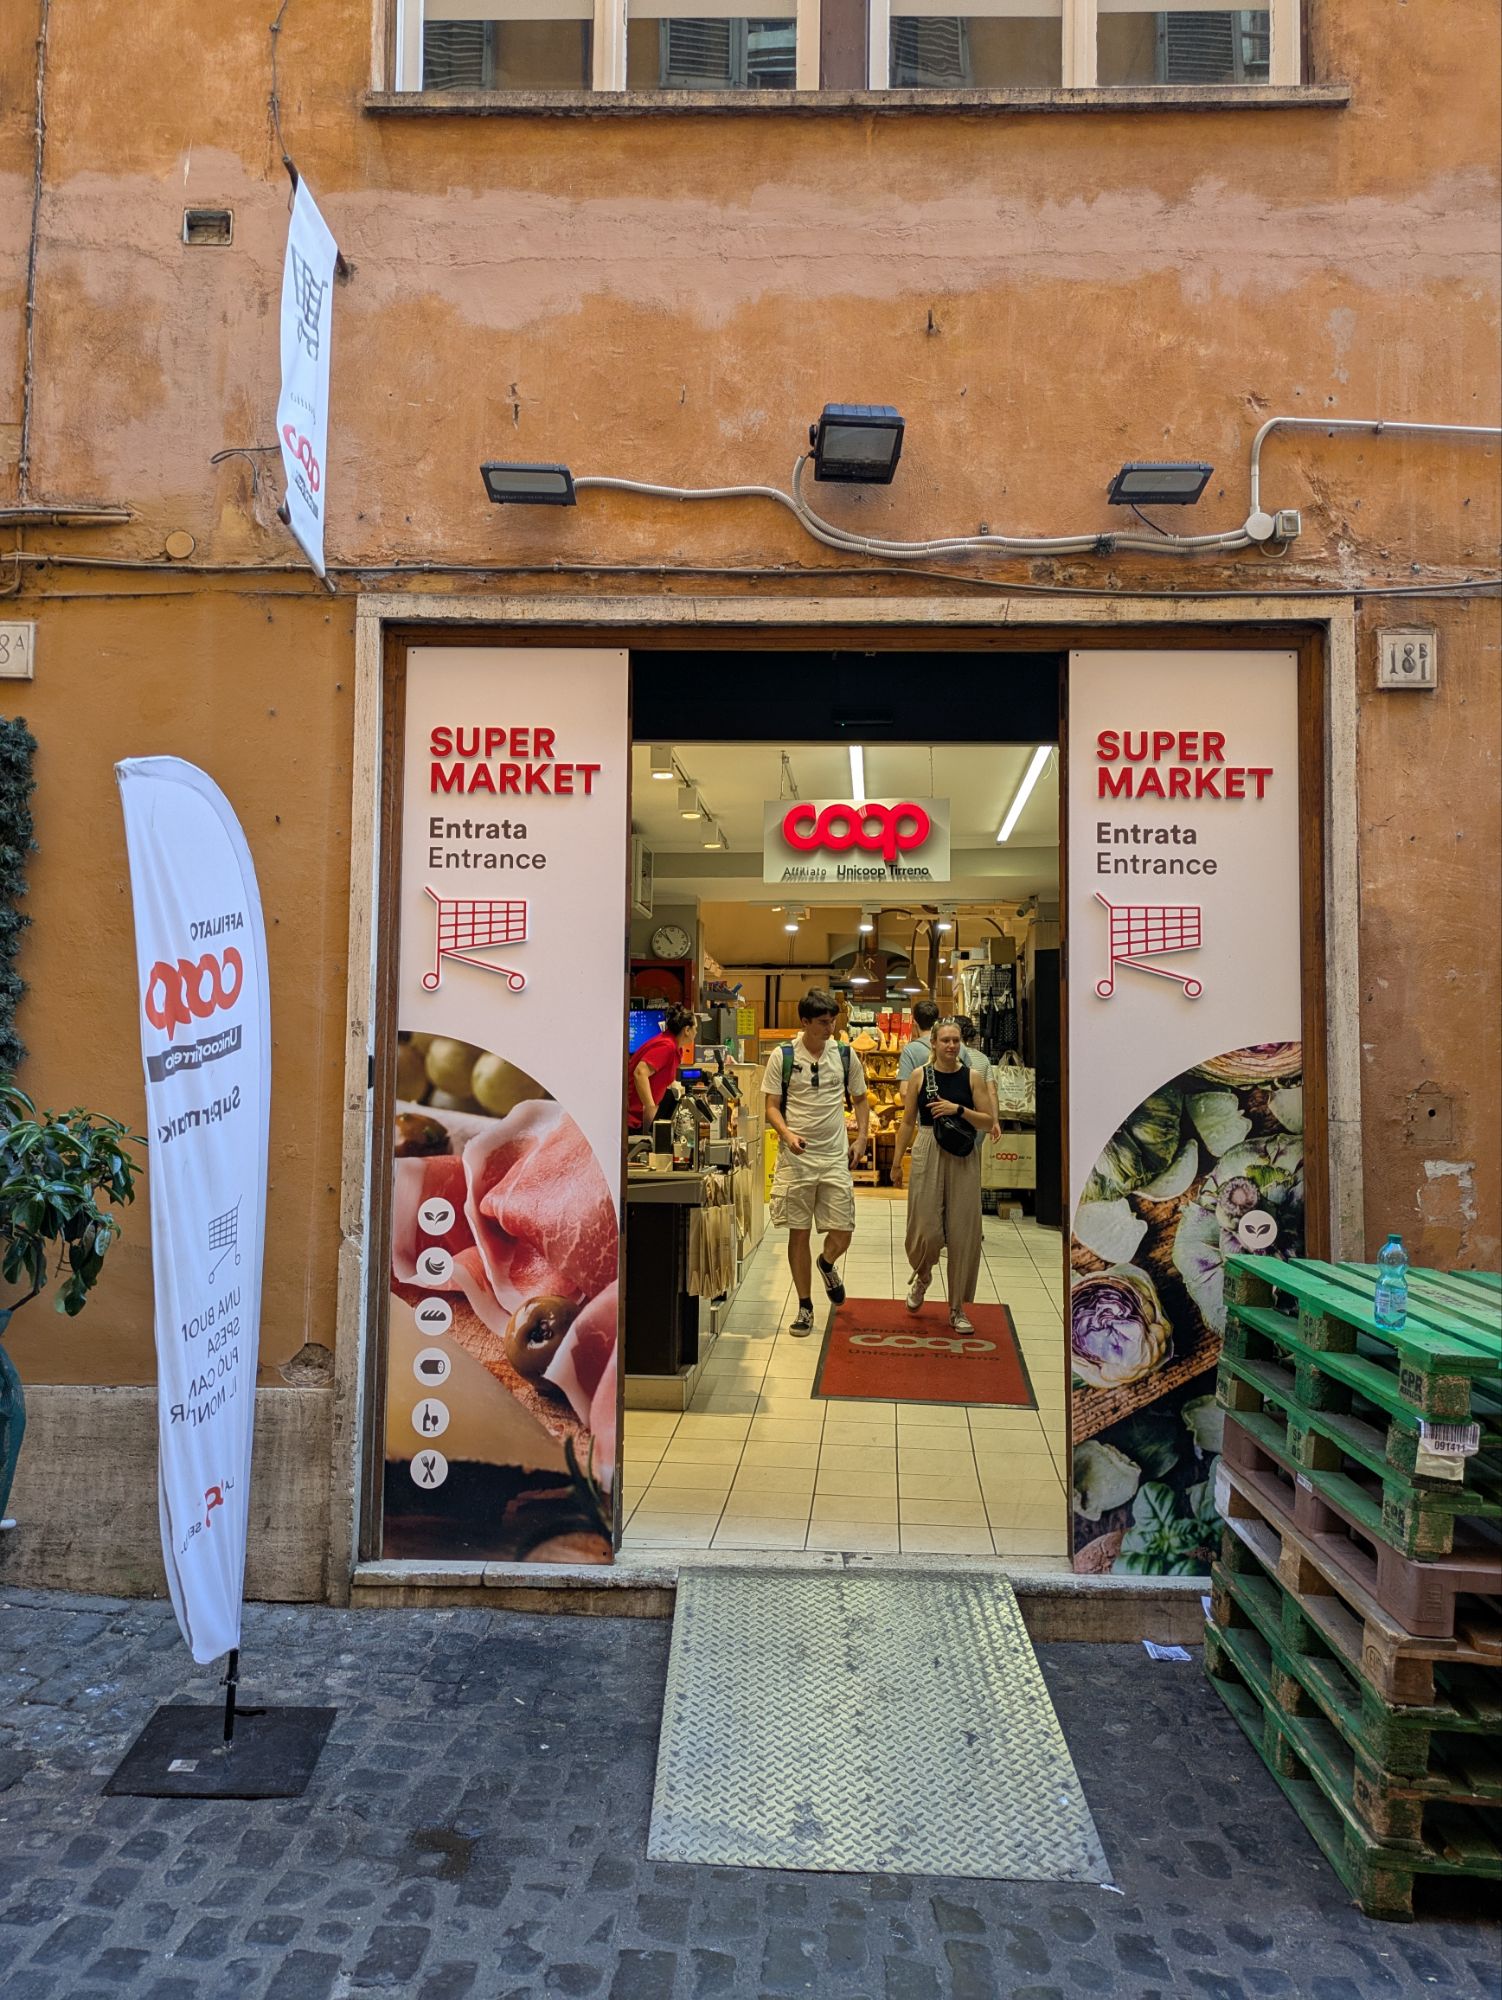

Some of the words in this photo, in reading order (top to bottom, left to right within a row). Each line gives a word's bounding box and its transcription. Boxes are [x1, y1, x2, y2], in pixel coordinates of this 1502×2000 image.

[430, 727, 556, 759] SUPER
[1097, 730, 1226, 762] SUPER
[431, 762, 602, 795] MARKET
[1098, 766, 1274, 799] MARKET
[430, 817, 528, 840] Entrata
[783, 802, 932, 861] coop
[1097, 822, 1198, 845] Entrata
[429, 847, 547, 870] Entrance
[1097, 852, 1219, 876] Entrance
[784, 867, 827, 877] Affiliato
[837, 865, 886, 879] Unicoop
[889, 865, 929, 876] Tirreno
[848, 1334, 997, 1353] coop
